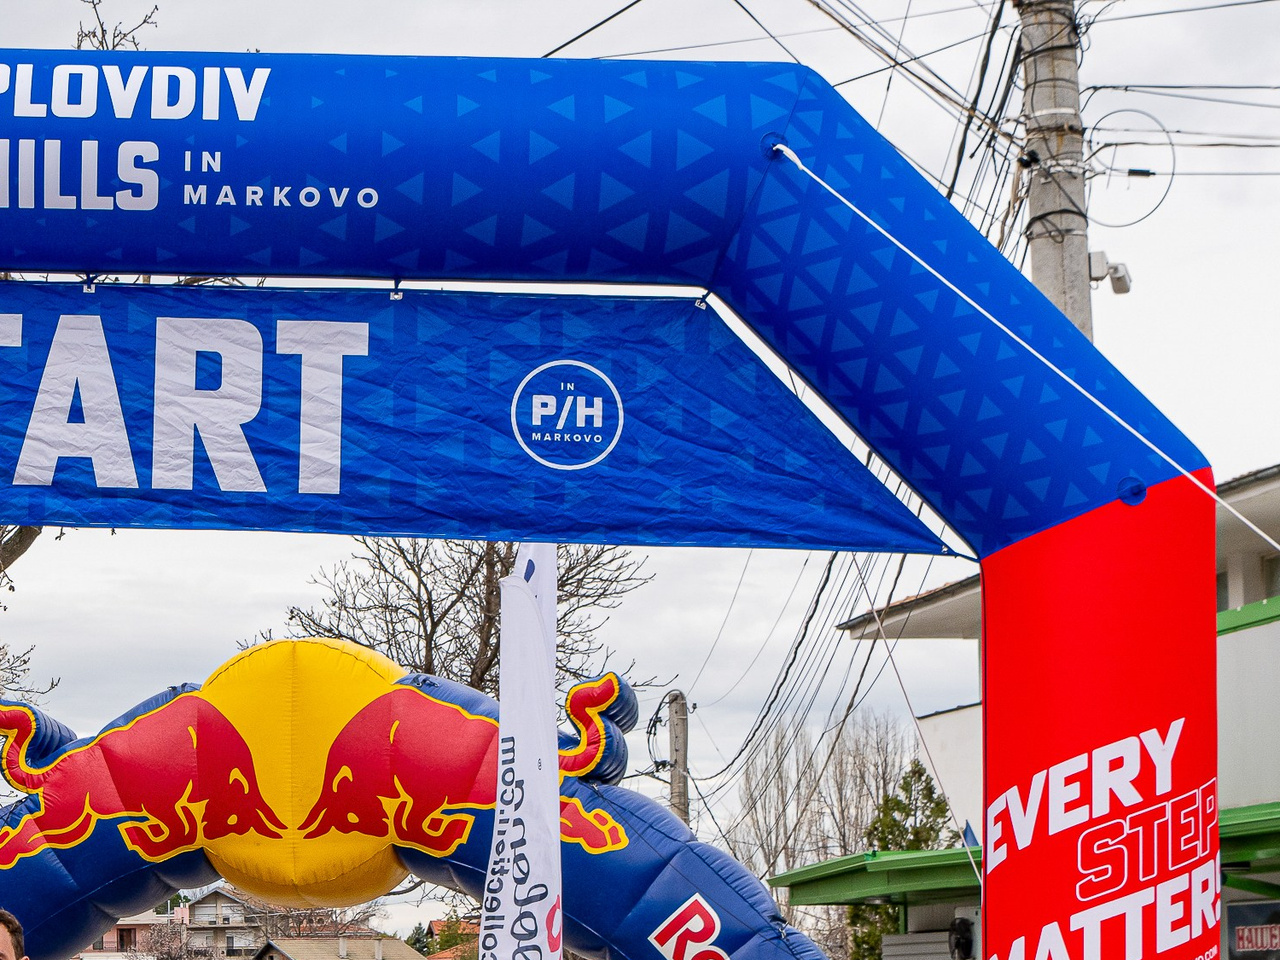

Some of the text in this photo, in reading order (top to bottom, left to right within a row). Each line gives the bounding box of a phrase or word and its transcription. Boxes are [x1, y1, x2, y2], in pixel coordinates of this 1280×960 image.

[184, 151, 222, 173] IN
[183, 184, 380, 209] MARKOVO
[561, 382, 574, 390] IN
[532, 394, 603, 430] P/H
[532, 432, 602, 443] MARKOVO
[986, 717, 1186, 876] EVERY
[1075, 777, 1217, 902] STEP
